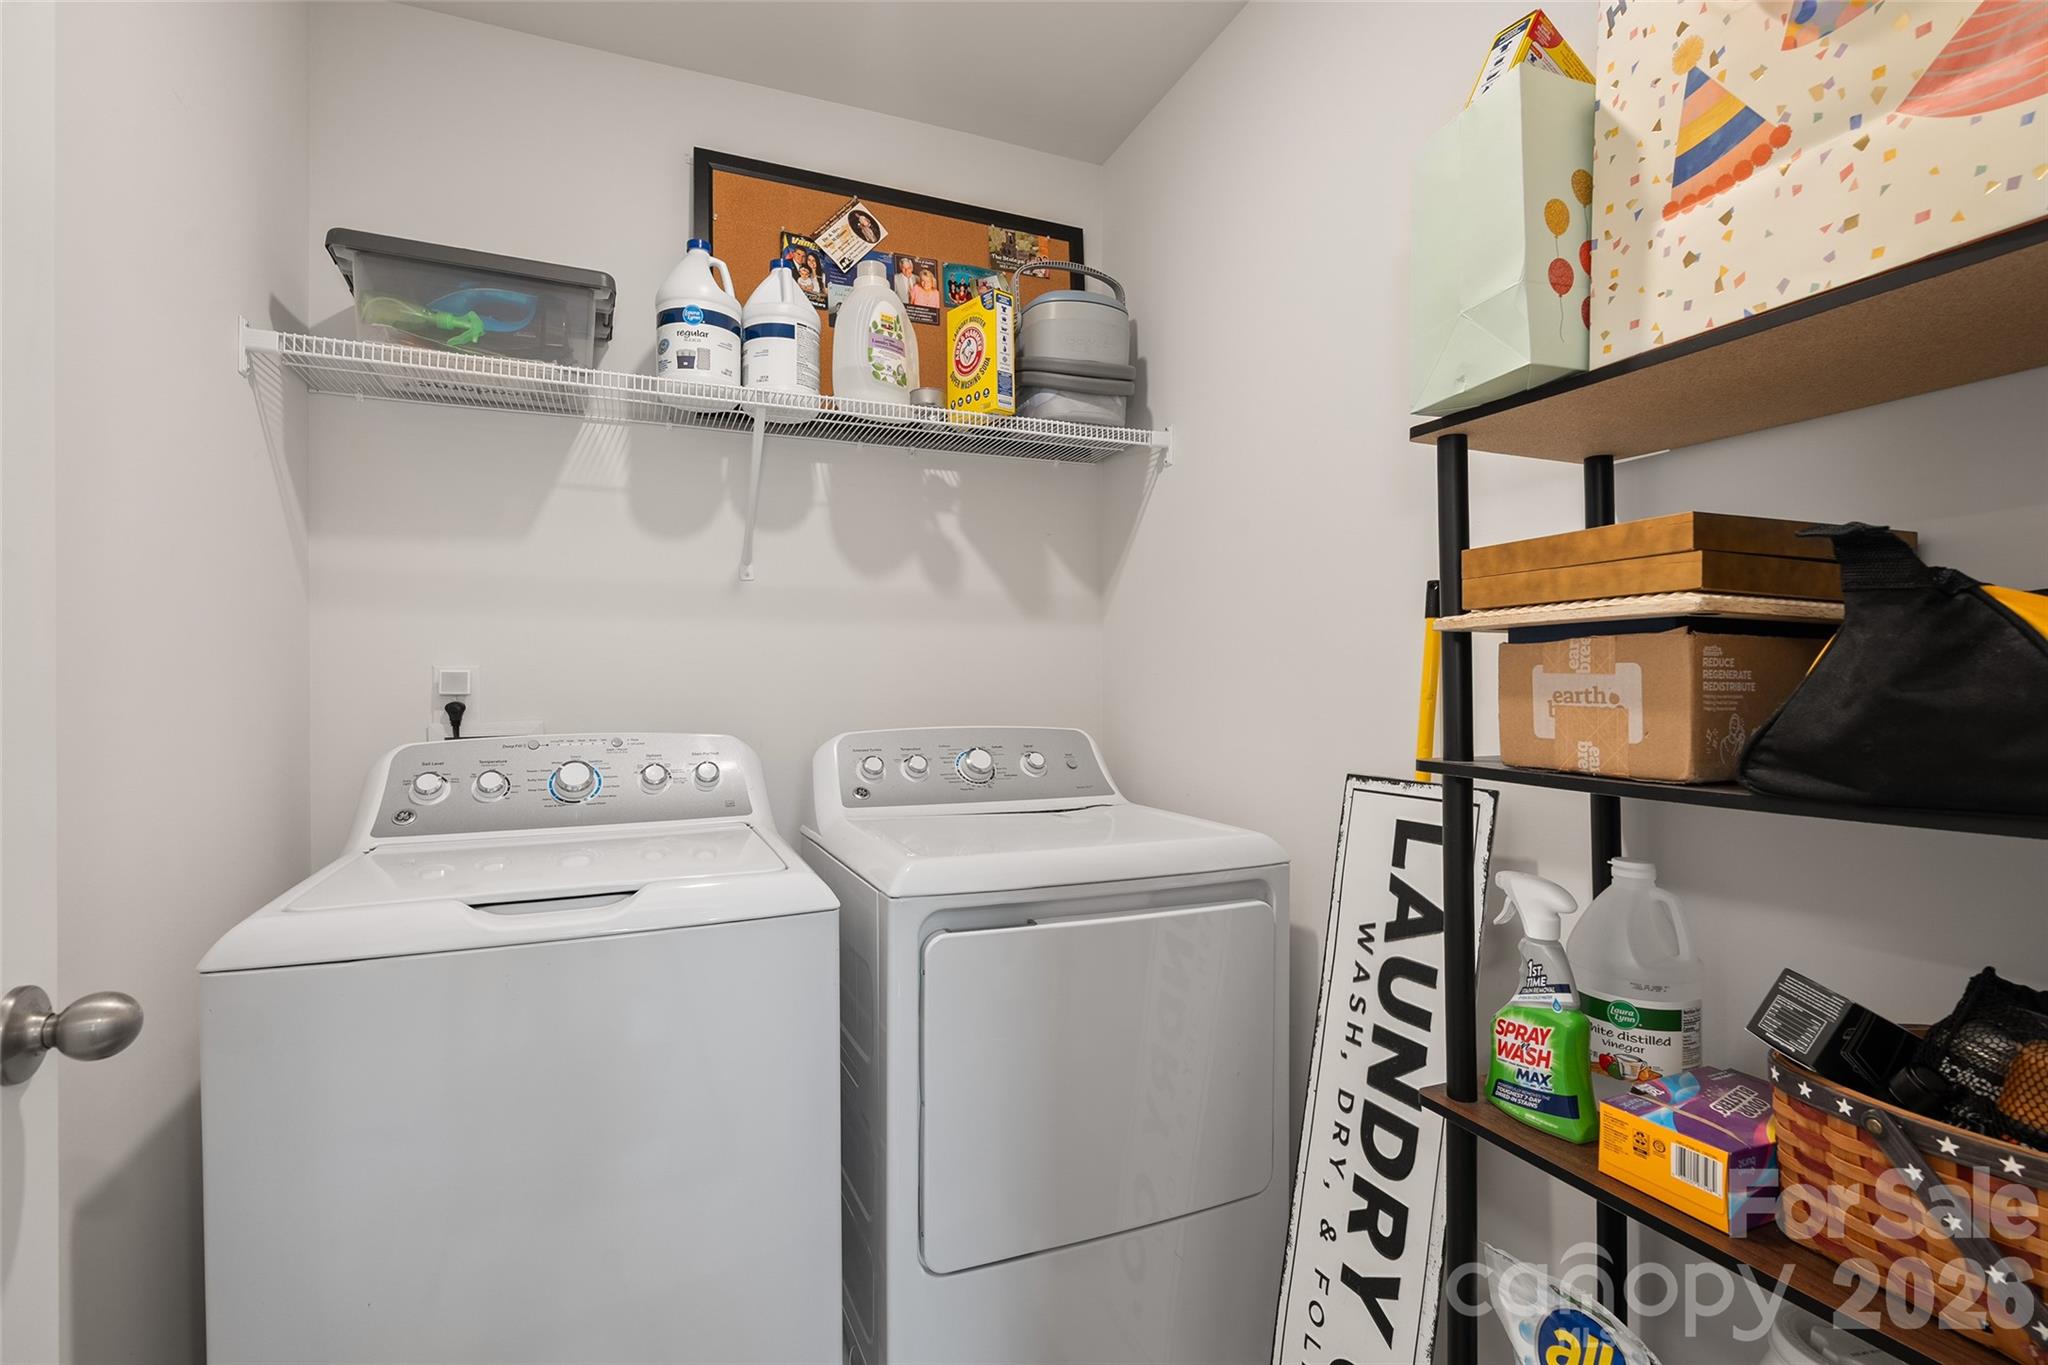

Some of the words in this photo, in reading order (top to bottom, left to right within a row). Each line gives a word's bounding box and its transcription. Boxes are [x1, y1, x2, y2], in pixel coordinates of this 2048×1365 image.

[676, 329, 709, 340] regular
[980, 357, 991, 375] SODA
[1702, 657, 1735, 668] REDUCE
[1702, 669, 1753, 680] REGENERATE
[1552, 685, 1608, 705] earth
[1702, 681, 1757, 692] REDISTRIBUTE
[1527, 958, 1543, 977] 1ST
[1339, 921, 1377, 1061] WASH,
[1526, 975, 1548, 988] TIME
[1609, 1006, 1635, 1017] Laura
[1614, 1014, 1637, 1024] Lynn
[1494, 1018, 1553, 1047] SPRAY
[1590, 1021, 1615, 1038] hite
[1616, 1031, 1672, 1047] distilled
[1496, 1038, 1552, 1070] WASH
[1601, 1038, 1646, 1055] vinegar
[1340, 817, 1446, 1351] LAUNDRY
[1516, 1068, 1552, 1087] MAX
[1496, 1086, 1524, 1099] TOUGHEST
[1711, 1085, 1758, 1115] BLASTERS
[1517, 1097, 1539, 1109] STAINS
[1736, 1099, 1769, 1118] ODOR
[1322, 1088, 1356, 1189] DRY,
[1318, 1217, 1338, 1244] &
[1302, 1267, 1331, 1365] FOL
[1545, 1327, 1614, 1365] all
